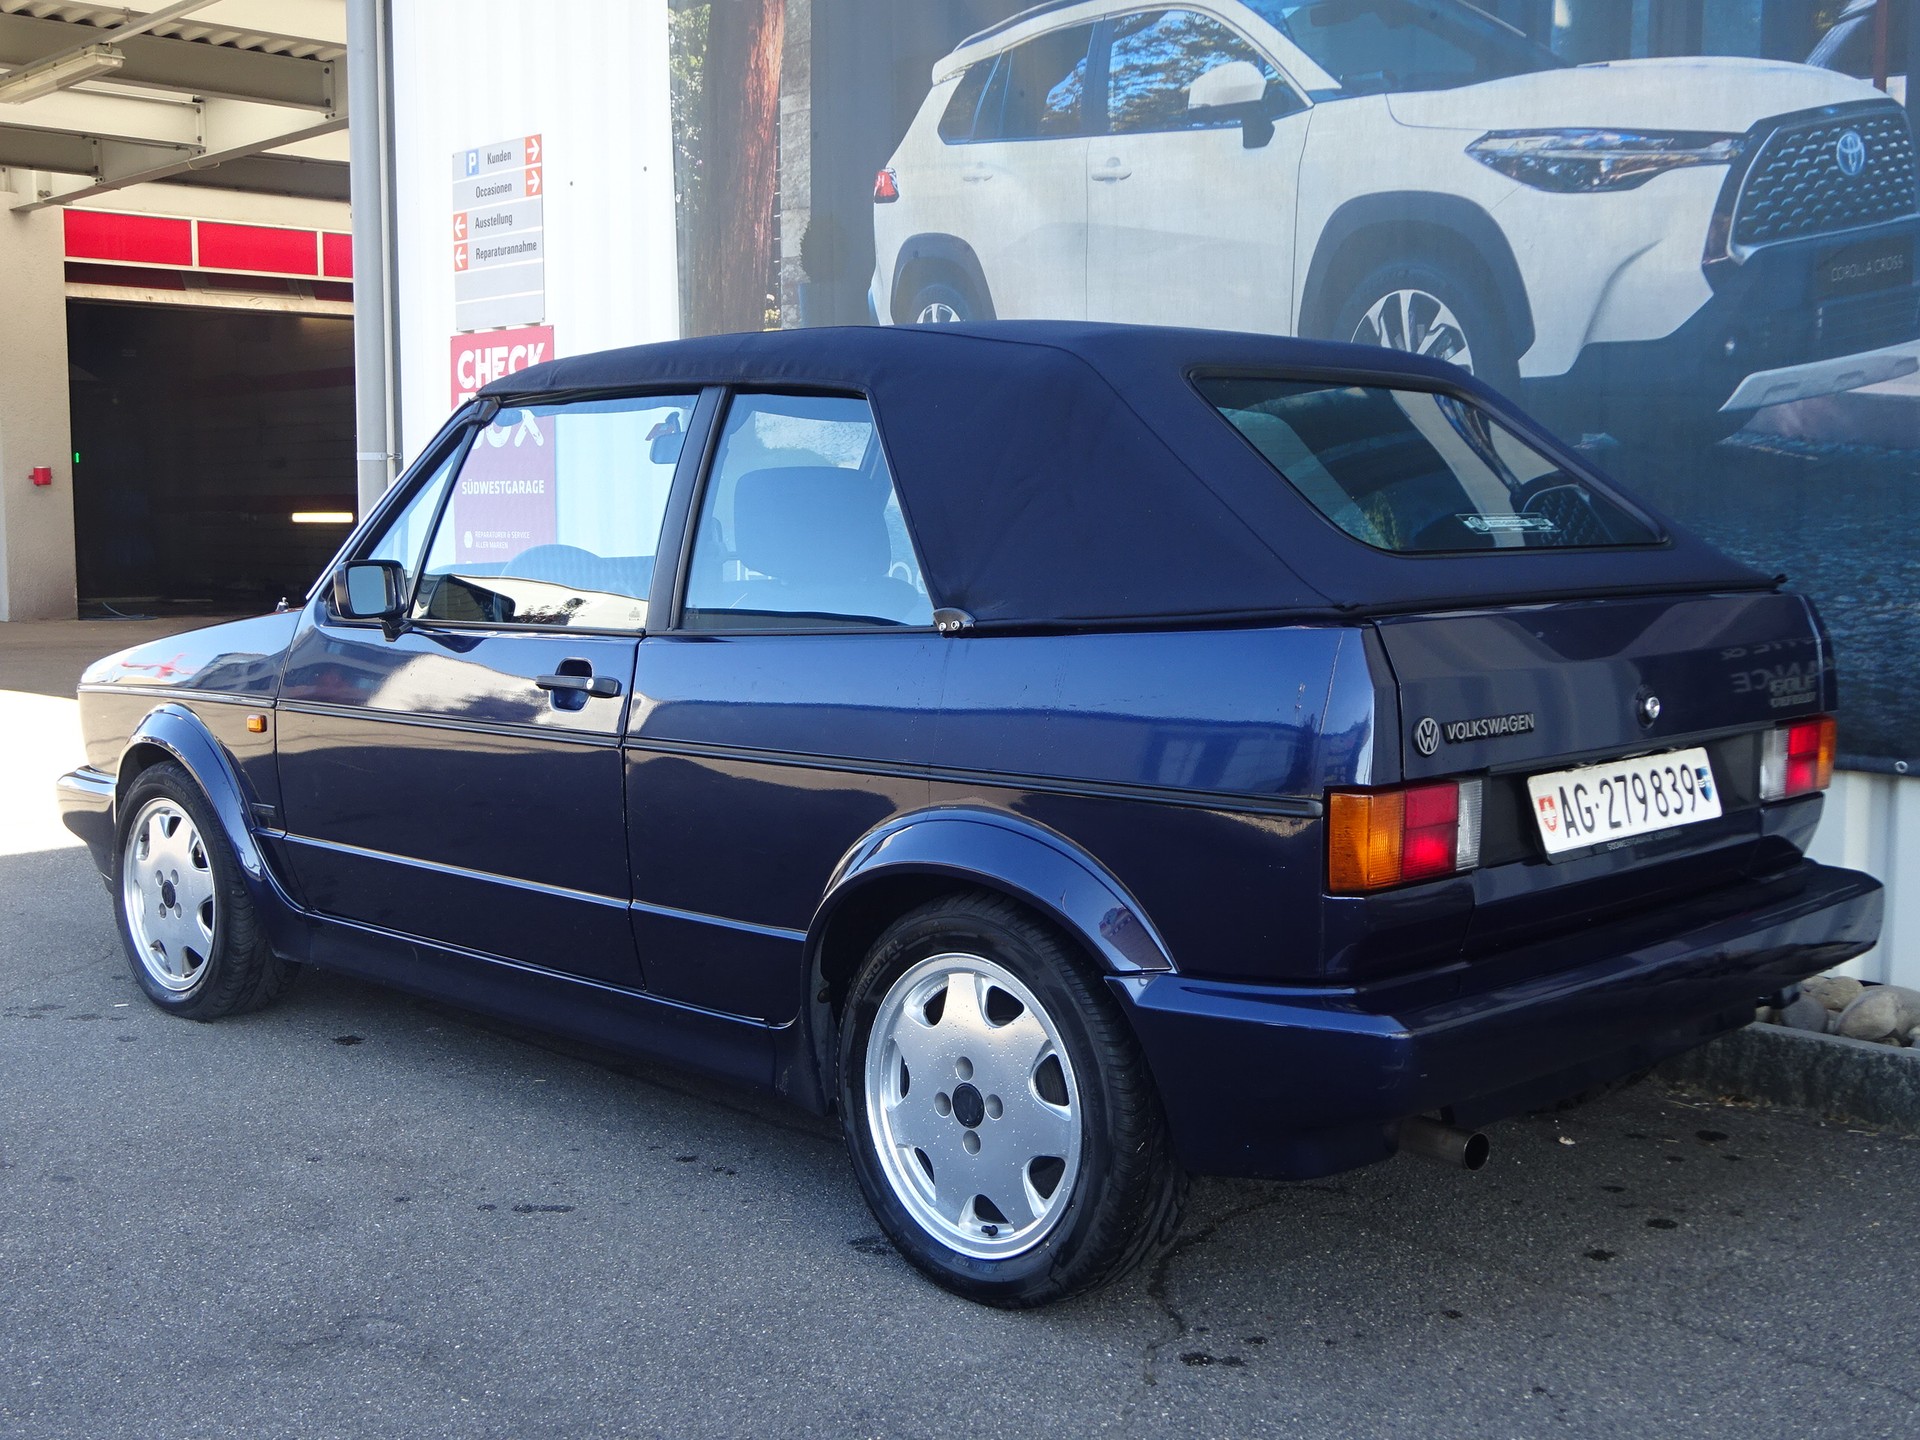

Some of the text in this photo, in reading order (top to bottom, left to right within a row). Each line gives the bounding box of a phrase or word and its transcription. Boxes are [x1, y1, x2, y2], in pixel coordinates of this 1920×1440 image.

[487, 150, 512, 165] Kunden
[475, 183, 512, 199] Occasionen
[475, 213, 513, 230] Ausstellung
[475, 240, 537, 261] Reparaturannahme
[457, 343, 545, 389] CHECK
[461, 479, 545, 495] SÜDWESTGARAGE
[1447, 713, 1535, 740] VOLKSWAGEN
